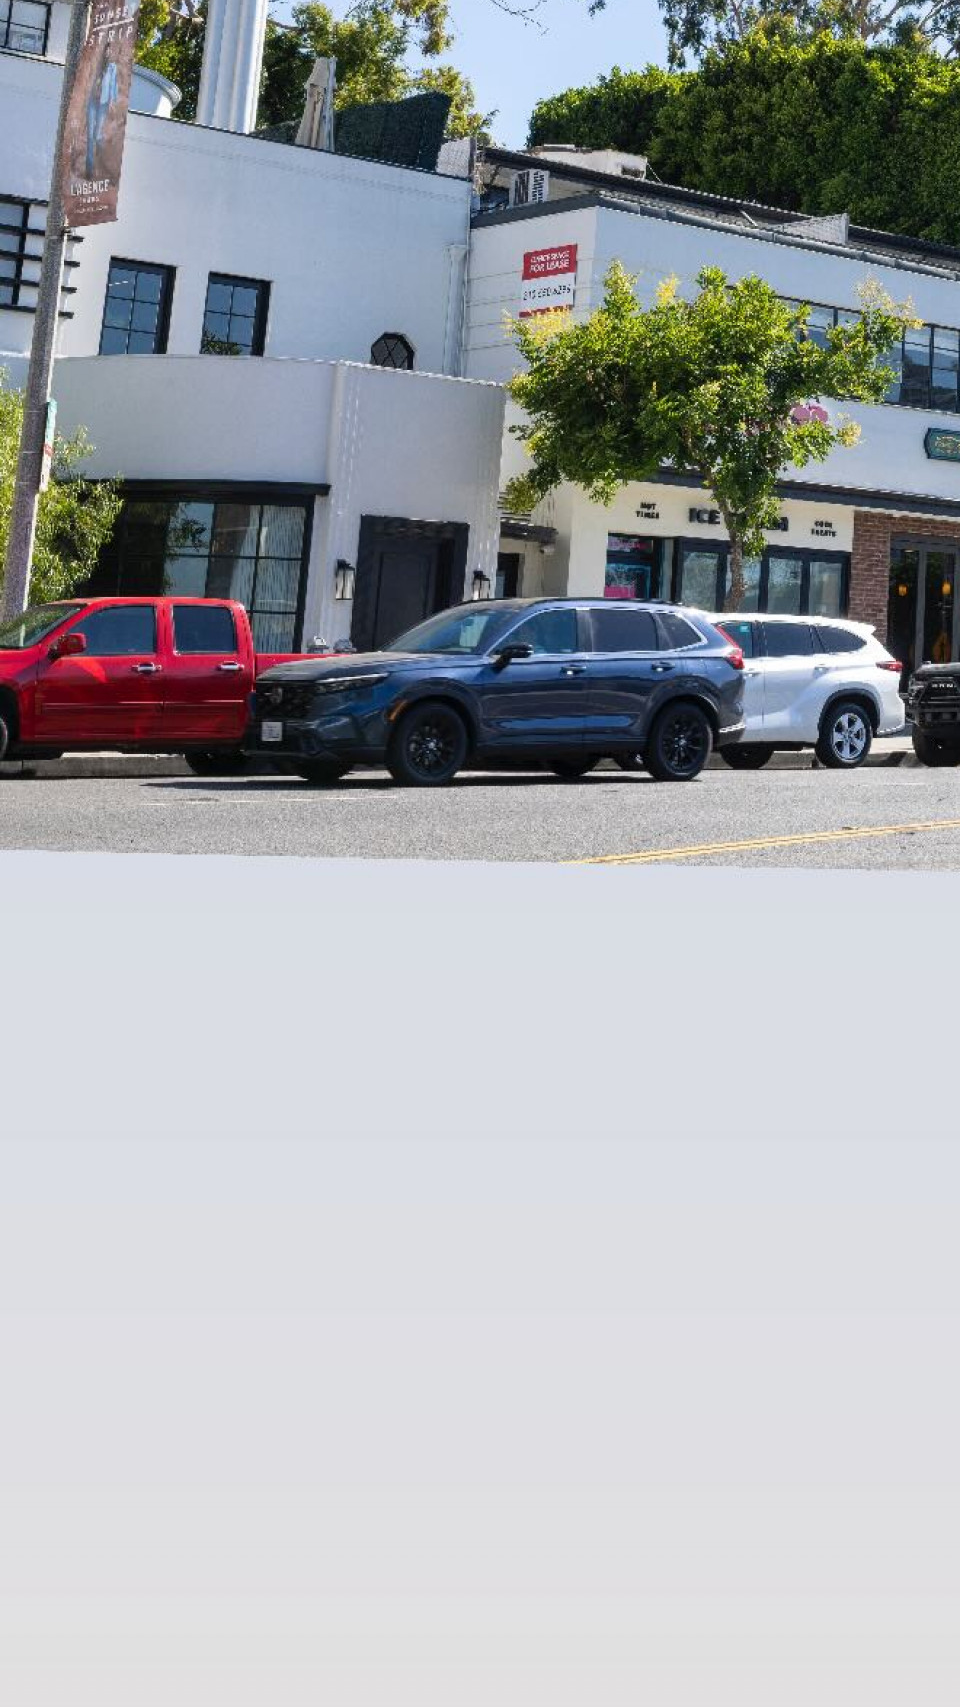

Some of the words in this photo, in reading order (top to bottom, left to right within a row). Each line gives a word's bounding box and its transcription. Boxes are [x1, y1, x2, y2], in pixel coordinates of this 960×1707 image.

[530, 263, 545, 273] FOR
[546, 258, 570, 271] LEASE
[689, 507, 720, 525] ICE
